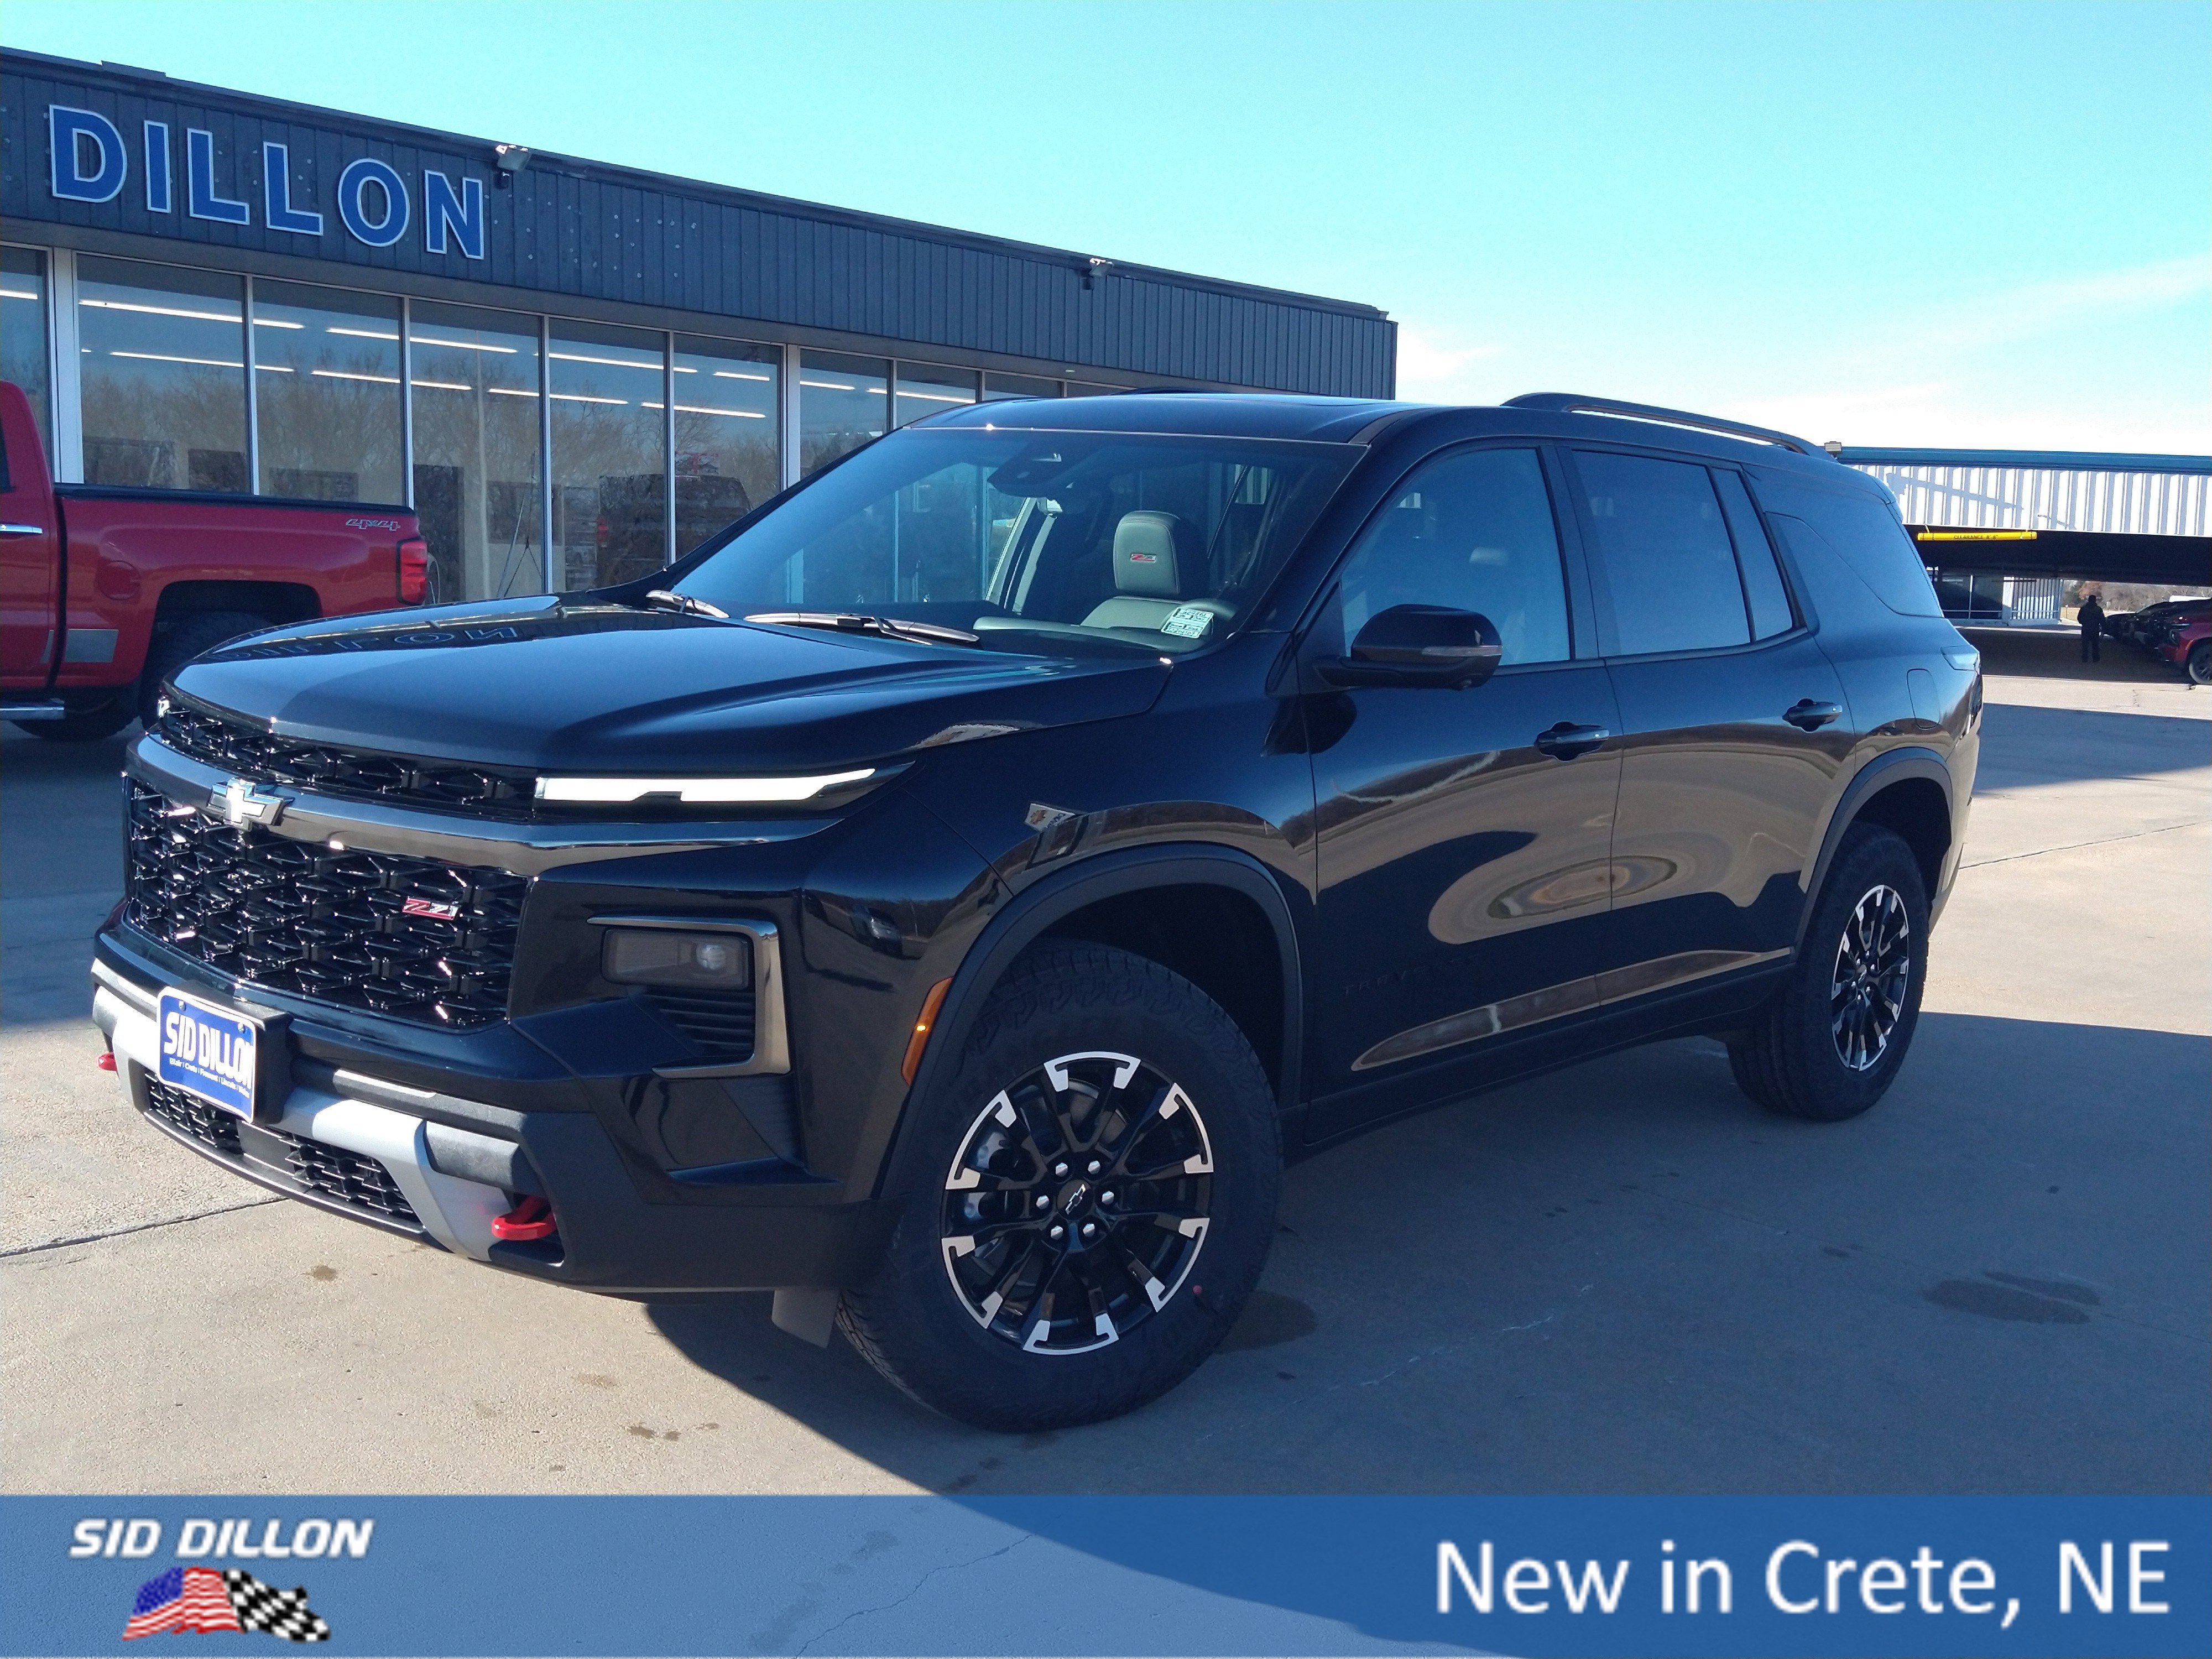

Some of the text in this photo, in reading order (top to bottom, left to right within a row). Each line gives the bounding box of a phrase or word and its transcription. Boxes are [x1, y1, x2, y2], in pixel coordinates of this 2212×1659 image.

[49, 103, 484, 260] DILLON
[402, 897, 459, 920] Z71
[164, 1011, 253, 1090] SID DILLON
